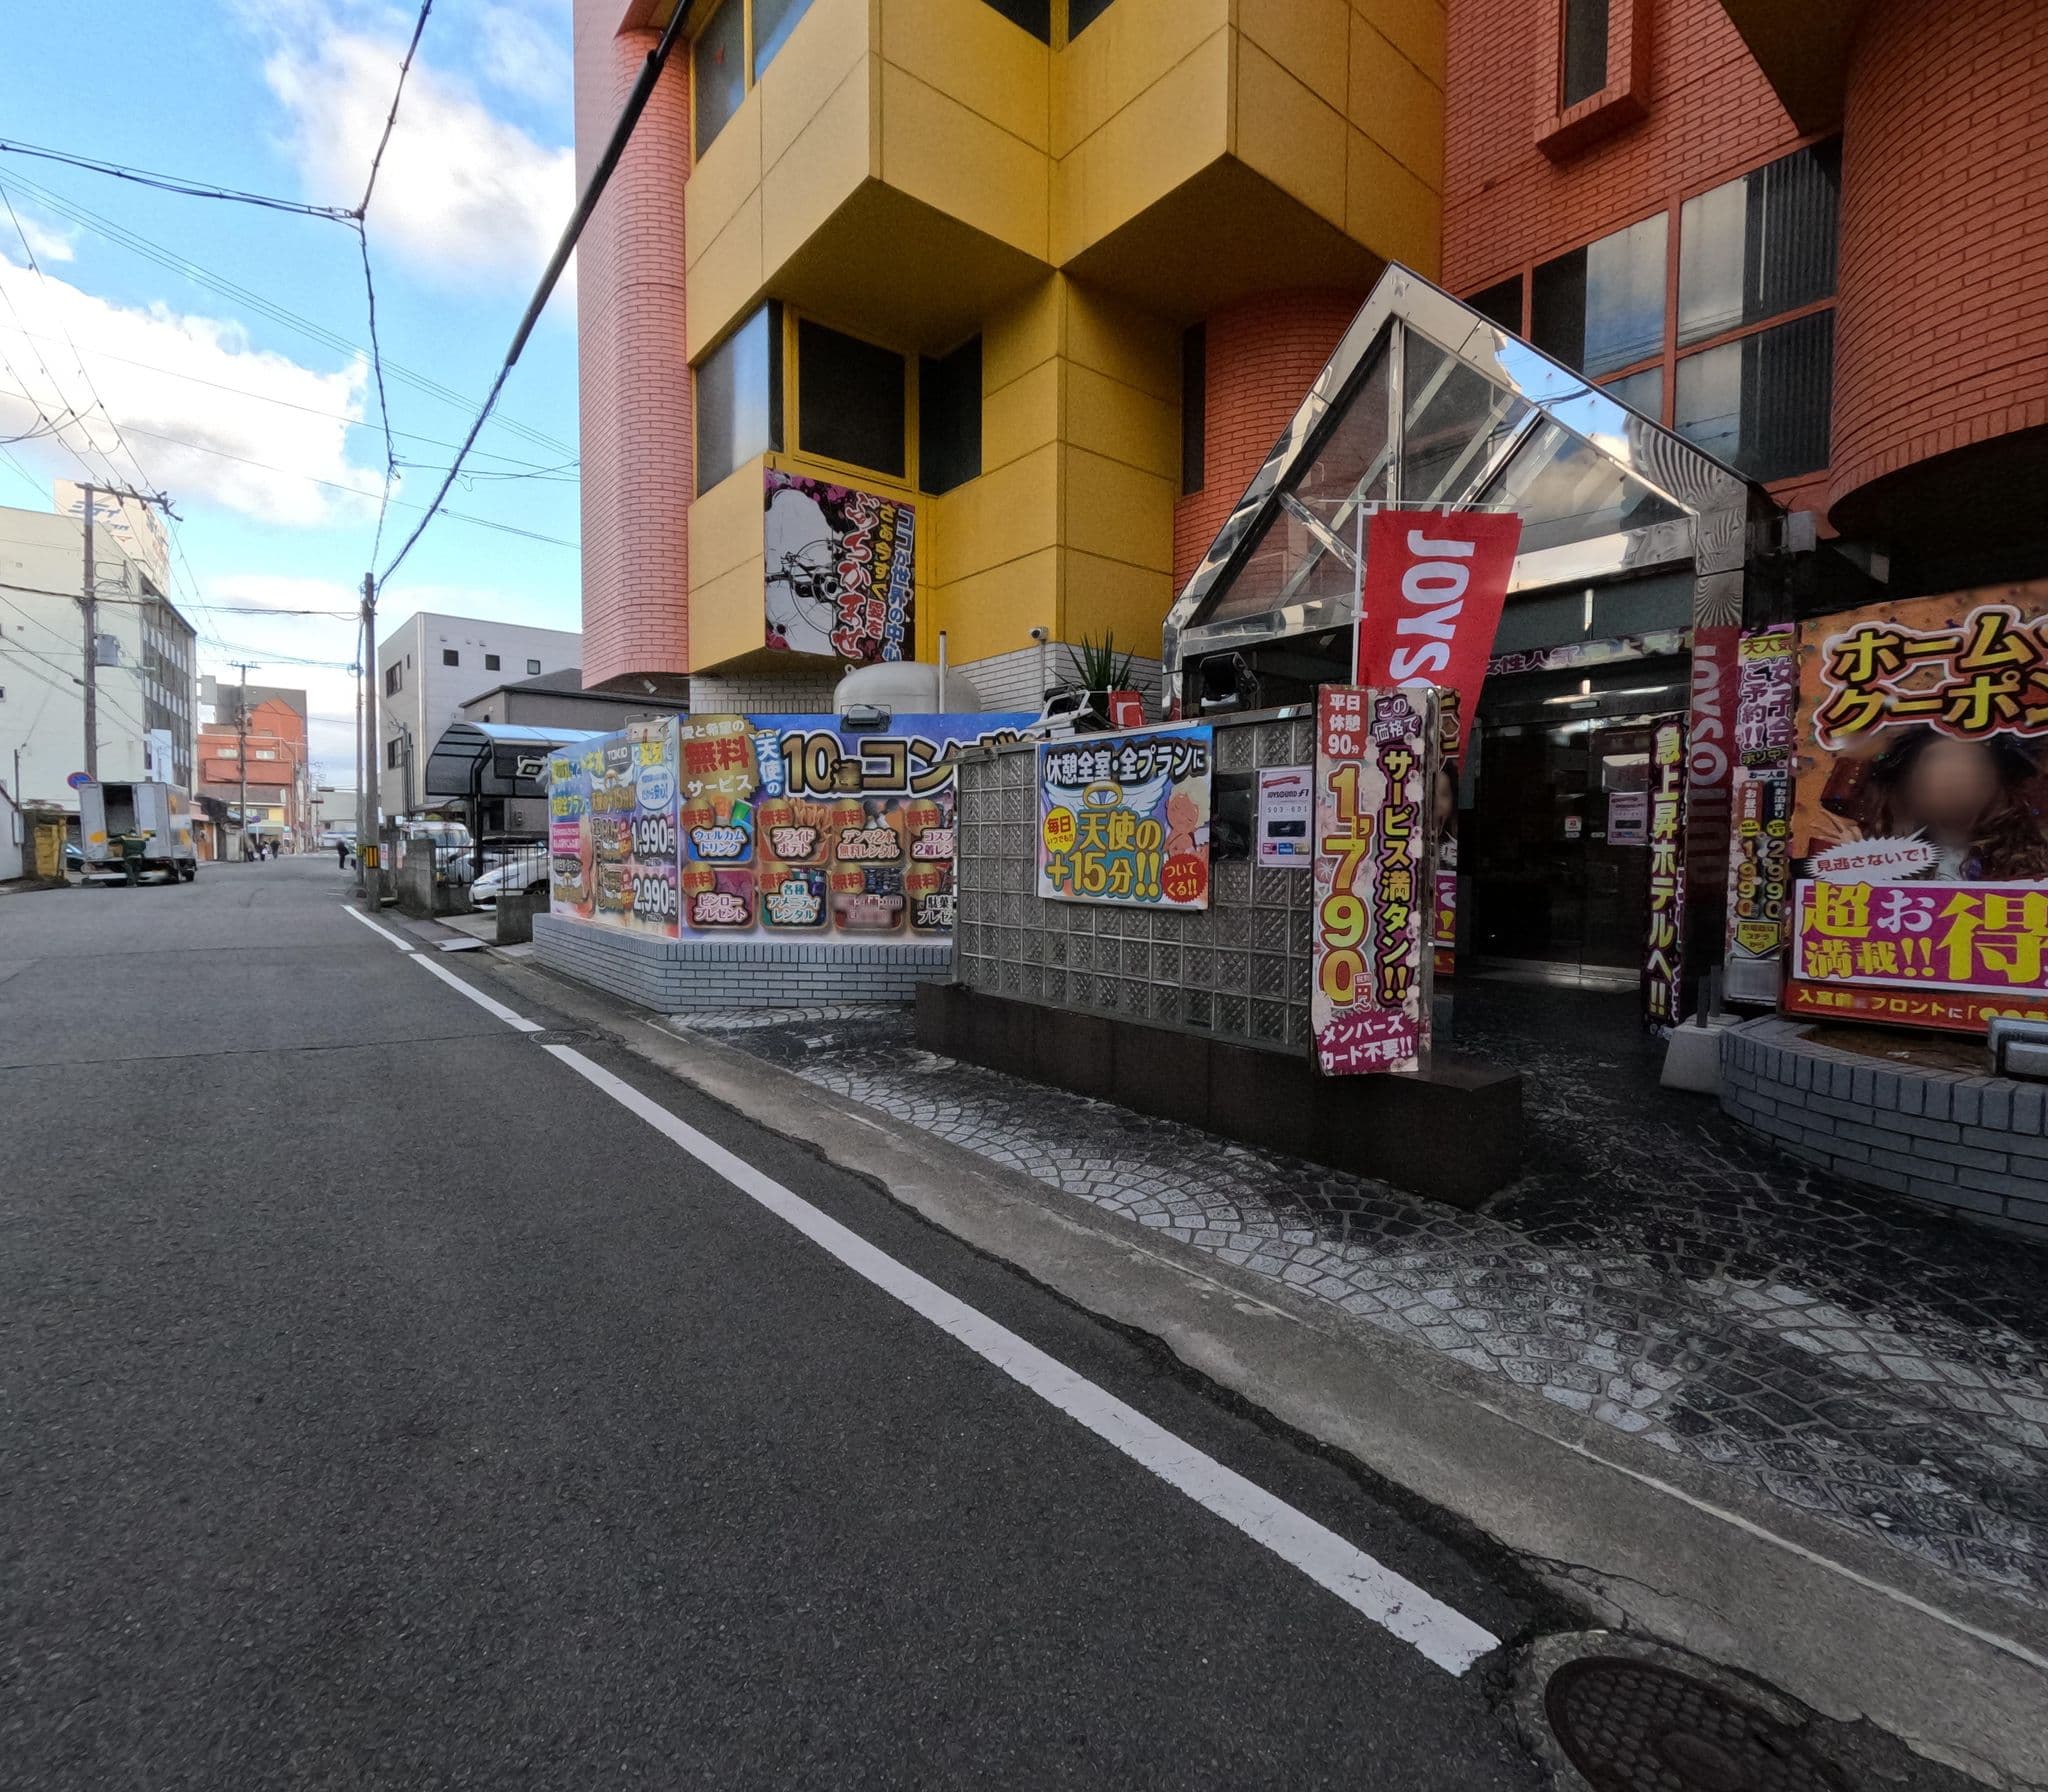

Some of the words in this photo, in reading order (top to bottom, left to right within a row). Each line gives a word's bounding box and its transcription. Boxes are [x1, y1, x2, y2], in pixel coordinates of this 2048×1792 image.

[1389, 530, 1476, 688] JOYS
[1744, 639, 1792, 655] 大人気
[1835, 614, 2048, 682] ホーム
[1329, 693, 1361, 712] 平日
[1378, 697, 1408, 718] この
[1742, 661, 1768, 749] ご予約!!
[1769, 657, 1791, 747] 女子会
[1328, 714, 1361, 732] 休憩
[1374, 716, 1419, 741] 価格で
[1328, 733, 1360, 755] 90分
[607, 747, 628, 761] TOKIO
[685, 736, 749, 775] 無料
[756, 737, 783, 794] 天使の
[1047, 743, 1205, 785] 休憩全室・全プランに
[687, 775, 752, 797] サービス
[682, 808, 712, 826] 無料
[760, 808, 792, 826] 無料
[832, 809, 864, 826] 無料
[907, 809, 939, 826] 無料
[1047, 815, 1071, 834] 毎日
[631, 818, 668, 856] 1,990
[694, 830, 744, 841] ウェルカム
[776, 830, 813, 841] フライド
[1080, 810, 1162, 850] 天使の
[701, 842, 739, 853] ドリンク
[779, 842, 809, 854] ポテト
[838, 843, 899, 857] 無料レンタル
[1165, 860, 1199, 878] ついて
[1816, 847, 1929, 873] 見逃さないで!
[683, 871, 713, 890] 無料
[1046, 851, 1160, 897] +15分!!
[1382, 751, 1413, 1000] サービス満タン!!
[1647, 725, 1681, 1017] 急上昇ホテルへ!!
[784, 884, 805, 895] 各種
[832, 872, 864, 890] 無料
[906, 873, 939, 890] 無料
[1167, 878, 1197, 896] くる!!
[1322, 766, 1371, 1003] 1,790
[633, 877, 669, 914] 2,990
[769, 896, 818, 907] アメニティ
[696, 907, 746, 919] プレゼント
[774, 908, 815, 919] レンタル
[1806, 937, 1935, 979] 満載!!
[1322, 1013, 1405, 1046] メンバーズ
[1321, 1035, 1413, 1070] カード不要!!
